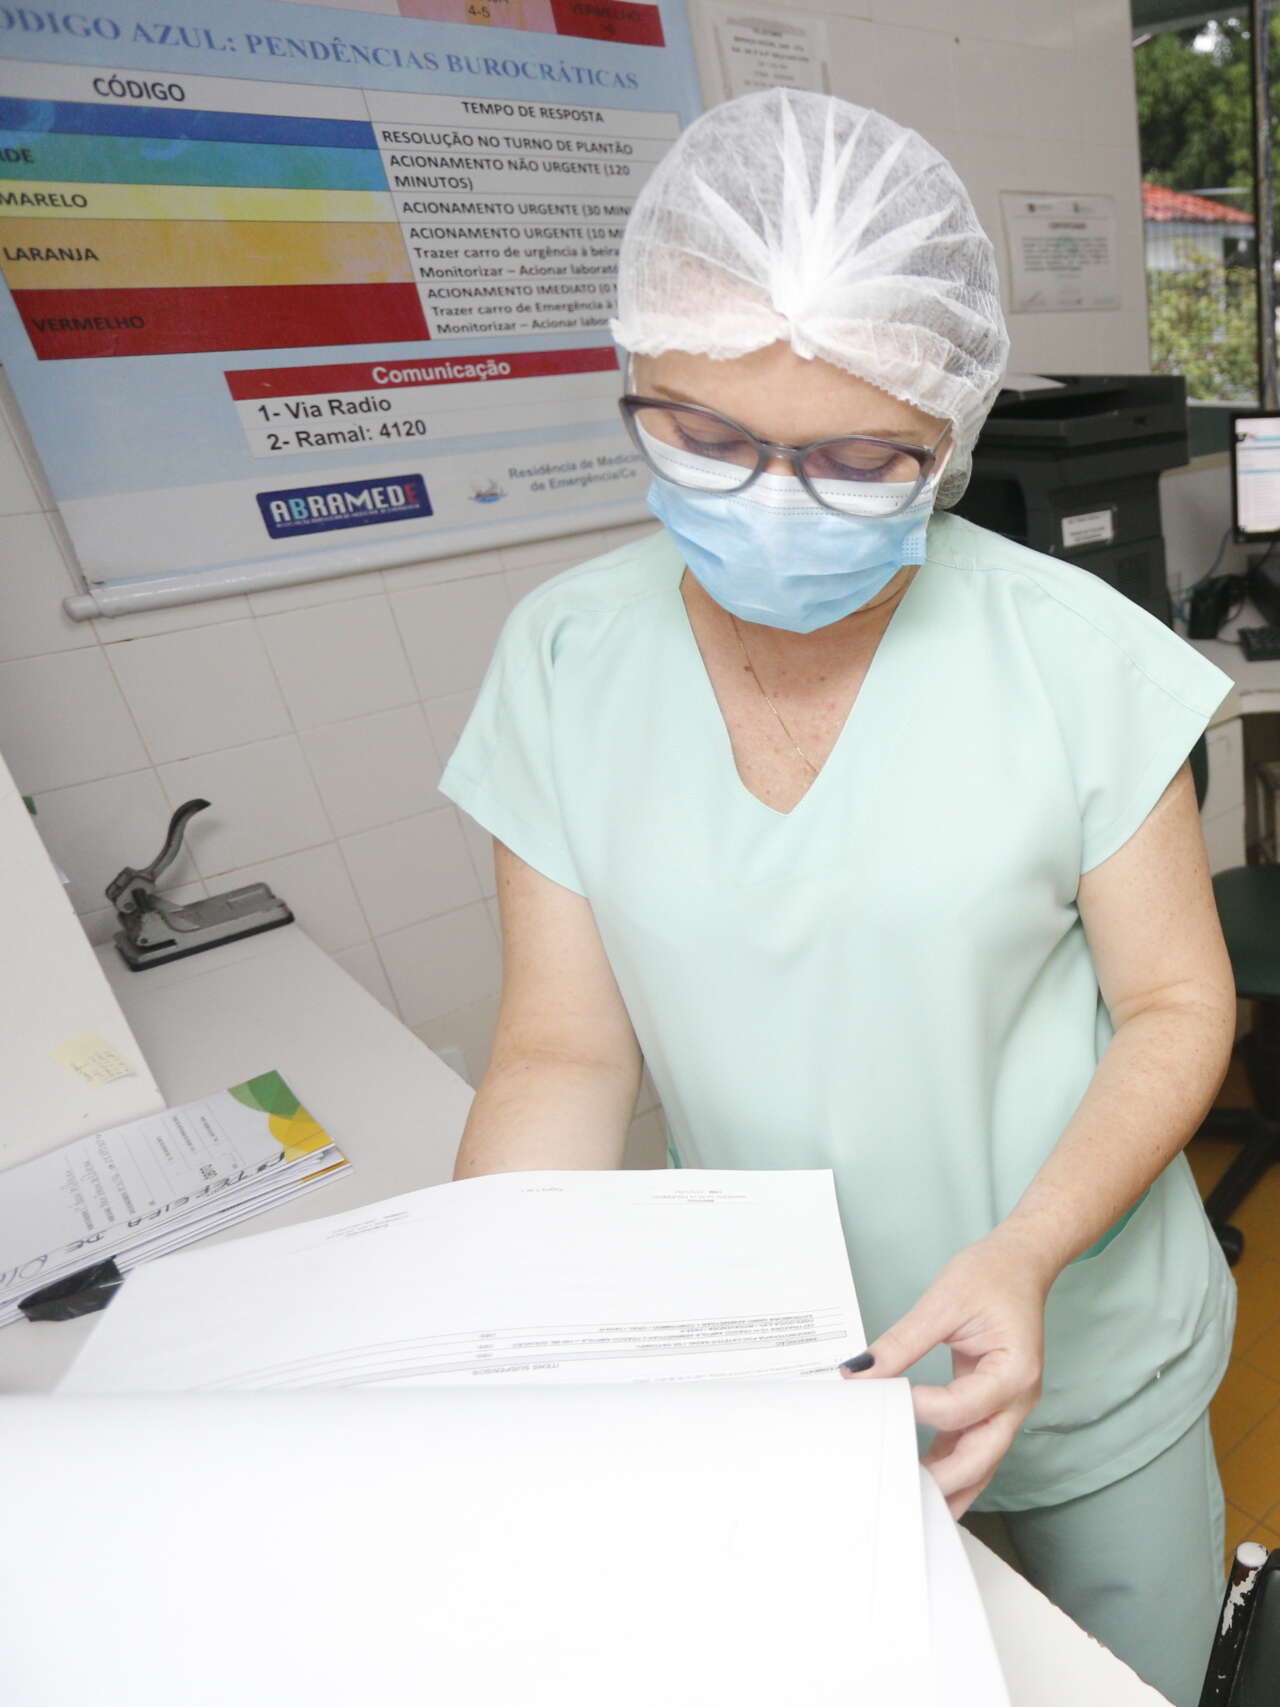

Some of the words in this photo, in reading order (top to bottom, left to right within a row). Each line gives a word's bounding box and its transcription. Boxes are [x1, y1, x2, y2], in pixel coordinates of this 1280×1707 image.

[131, 22, 237, 52] AZUL:
[244, 33, 440, 72] PENDÊNCIAS
[446, 53, 639, 91] BUROCRÁTICAS
[92, 74, 186, 102] CÓDIGO
[461, 101, 514, 116] TEMPO
[518, 105, 536, 118] DE
[540, 106, 604, 123] RESPOSTA
[382, 130, 474, 147] RESOLUÇÃO
[478, 135, 500, 148] NO
[503, 136, 553, 150] TURNO
[556, 139, 573, 152] DE
[576, 141, 633, 155] PLANTÃO
[389, 155, 504, 170] ACIONAMENTO
[508, 157, 539, 172] NÃO
[542, 162, 601, 175] URGENTE
[604, 164, 630, 177] (120
[394, 175, 473, 191] MINUTOS)
[402, 201, 514, 215] ACIONAMENTO
[519, 203, 577, 216] URGENTE
[582, 204, 600, 217] (30
[409, 227, 521, 240] ACIONAMENTO
[524, 228, 583, 239] URGENTE
[586, 228, 605, 241] (10
[3, 247, 99, 262] LARANJA
[413, 247, 458, 259] Trazer
[464, 249, 500, 258] carro
[504, 245, 520, 258] de
[524, 246, 577, 261] urgência
[420, 266, 503, 278] Monitorizar
[519, 264, 567, 276] Acionar
[428, 286, 533, 299] ACIONAMENTO
[536, 284, 597, 296] IMEDIATO
[431, 306, 473, 316] Trazer
[477, 305, 512, 315] carro
[516, 303, 531, 314] de
[535, 301, 603, 314] Emergência
[31, 316, 145, 332] VERMELHO
[437, 322, 516, 334] Monitorizar
[531, 318, 577, 329] Acionar
[371, 359, 511, 385] Comunicação
[258, 404, 281, 422] 1-
[284, 402, 323, 420] Via
[328, 396, 392, 416] Radio
[266, 433, 290, 450] 2-
[296, 425, 373, 448] Ramal:
[379, 419, 427, 439] 4120
[508, 462, 577, 479] Residência
[269, 482, 420, 523] ABRAMEDE
